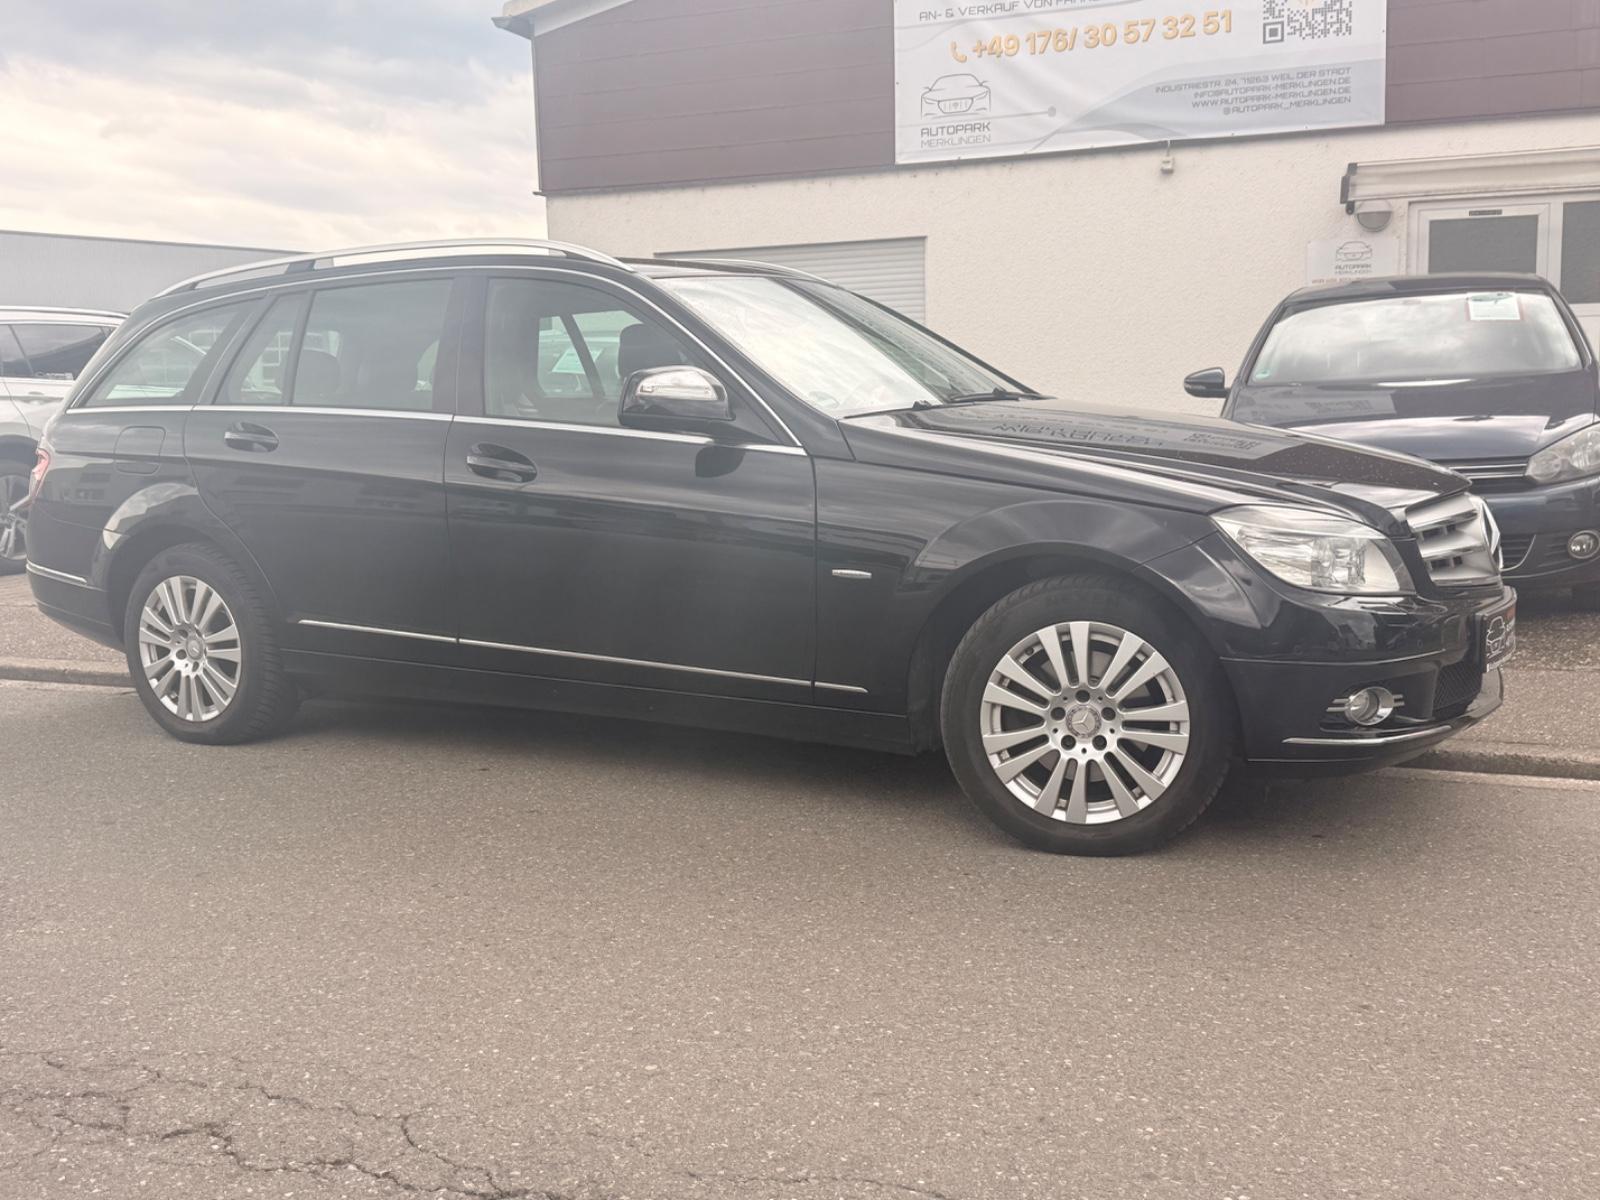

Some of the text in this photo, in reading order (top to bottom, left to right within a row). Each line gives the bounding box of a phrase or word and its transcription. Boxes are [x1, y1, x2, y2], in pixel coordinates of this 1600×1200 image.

[919, 11, 942, 21] AN-
[945, 8, 954, 18] &
[958, 1, 1021, 16] VERKAUF
[1023, 0, 1053, 9] VON
[972, 9, 1233, 58] +49 176/ 30 57 32 51
[1296, 70, 1316, 79] DER
[1318, 67, 1352, 77] STADT
[1191, 86, 1352, 108] WWW.AUTOPARK-MERKLINGEN.DE
[920, 121, 991, 138] AUTOPARK
[920, 134, 991, 149] MERKLINGEN
